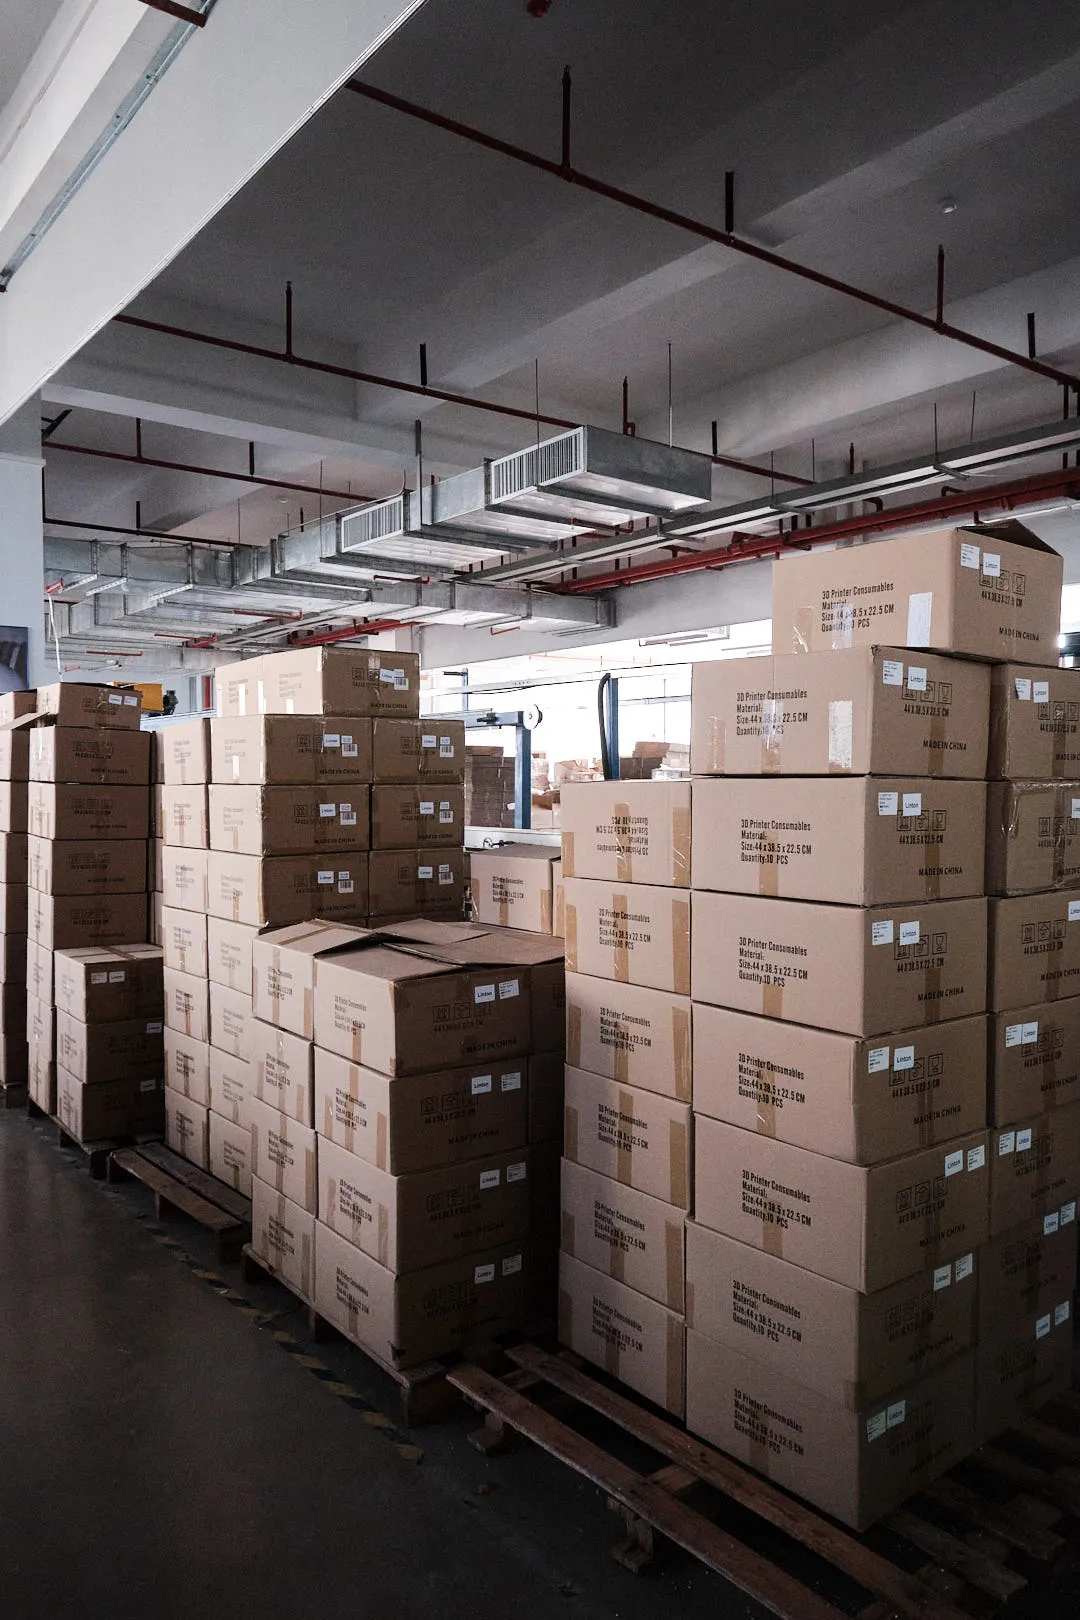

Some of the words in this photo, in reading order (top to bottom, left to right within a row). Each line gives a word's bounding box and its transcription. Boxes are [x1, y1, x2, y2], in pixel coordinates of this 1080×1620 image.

[822, 589, 829, 599] 3D
[831, 586, 851, 598] Printer
[852, 581, 893, 595] Consumables
[868, 605, 882, 615] 22.5
[884, 603, 893, 613] CM
[857, 617, 869, 628] PCS
[999, 625, 1015, 637] MADE
[1016, 629, 1021, 638] IN
[1022, 630, 1039, 642] CHINA
[736, 692, 744, 701] 3D
[745, 690, 765, 701] Printer
[767, 688, 807, 699] Consumables
[736, 702, 762, 713] Material:
[941, 707, 949, 717] CM
[782, 712, 796, 722] 22.5
[797, 712, 807, 721] CM
[923, 739, 941, 749] MADE
[941, 741, 947, 749] IN
[948, 741, 966, 751] CHINA
[741, 818, 748, 827] 3D
[750, 819, 770, 828] Printer
[771, 820, 810, 830] Consumables
[741, 830, 767, 839] Material:
[935, 834, 943, 844] CM
[786, 843, 800, 853] 22.5
[801, 844, 811, 854] CM
[776, 854, 788, 864] PCS
[918, 867, 936, 876] MADE
[936, 866, 943, 875] IN
[944, 866, 962, 875] CHINA
[739, 935, 746, 945] 3D
[747, 937, 767, 949] Printer
[768, 941, 807, 956] Consumables
[739, 947, 764, 960] Material:
[936, 956, 944, 967] CM
[783, 966, 797, 978] 22.5
[798, 968, 807, 980] CM
[773, 975, 785, 987] PCS
[917, 990, 936, 1001] MADE
[936, 989, 943, 999] IN
[944, 986, 963, 997] CHINA
[738, 1052, 745, 1062] 3D
[746, 1055, 765, 1068] Printer
[766, 1061, 804, 1079] Consumables
[738, 1064, 763, 1078] Material:
[781, 1087, 794, 1099] 22.5
[795, 1091, 805, 1102] CM
[771, 1096, 783, 1107] PCS
[742, 1169, 749, 1179] 3D
[750, 1172, 770, 1187] Printer
[771, 1180, 810, 1202] Consumables
[742, 1180, 767, 1197] Material:
[776, 1215, 788, 1228] PCS
[786, 1208, 800, 1221] 22.5
[801, 1214, 811, 1226] CM
[732, 1279, 740, 1290] 3D
[741, 1283, 760, 1300] Printer
[762, 1293, 800, 1318] Consumables
[732, 1290, 758, 1310] Material:
[767, 1328, 778, 1342] PCS
[777, 1322, 790, 1336] 22.5
[791, 1329, 801, 1341] CM
